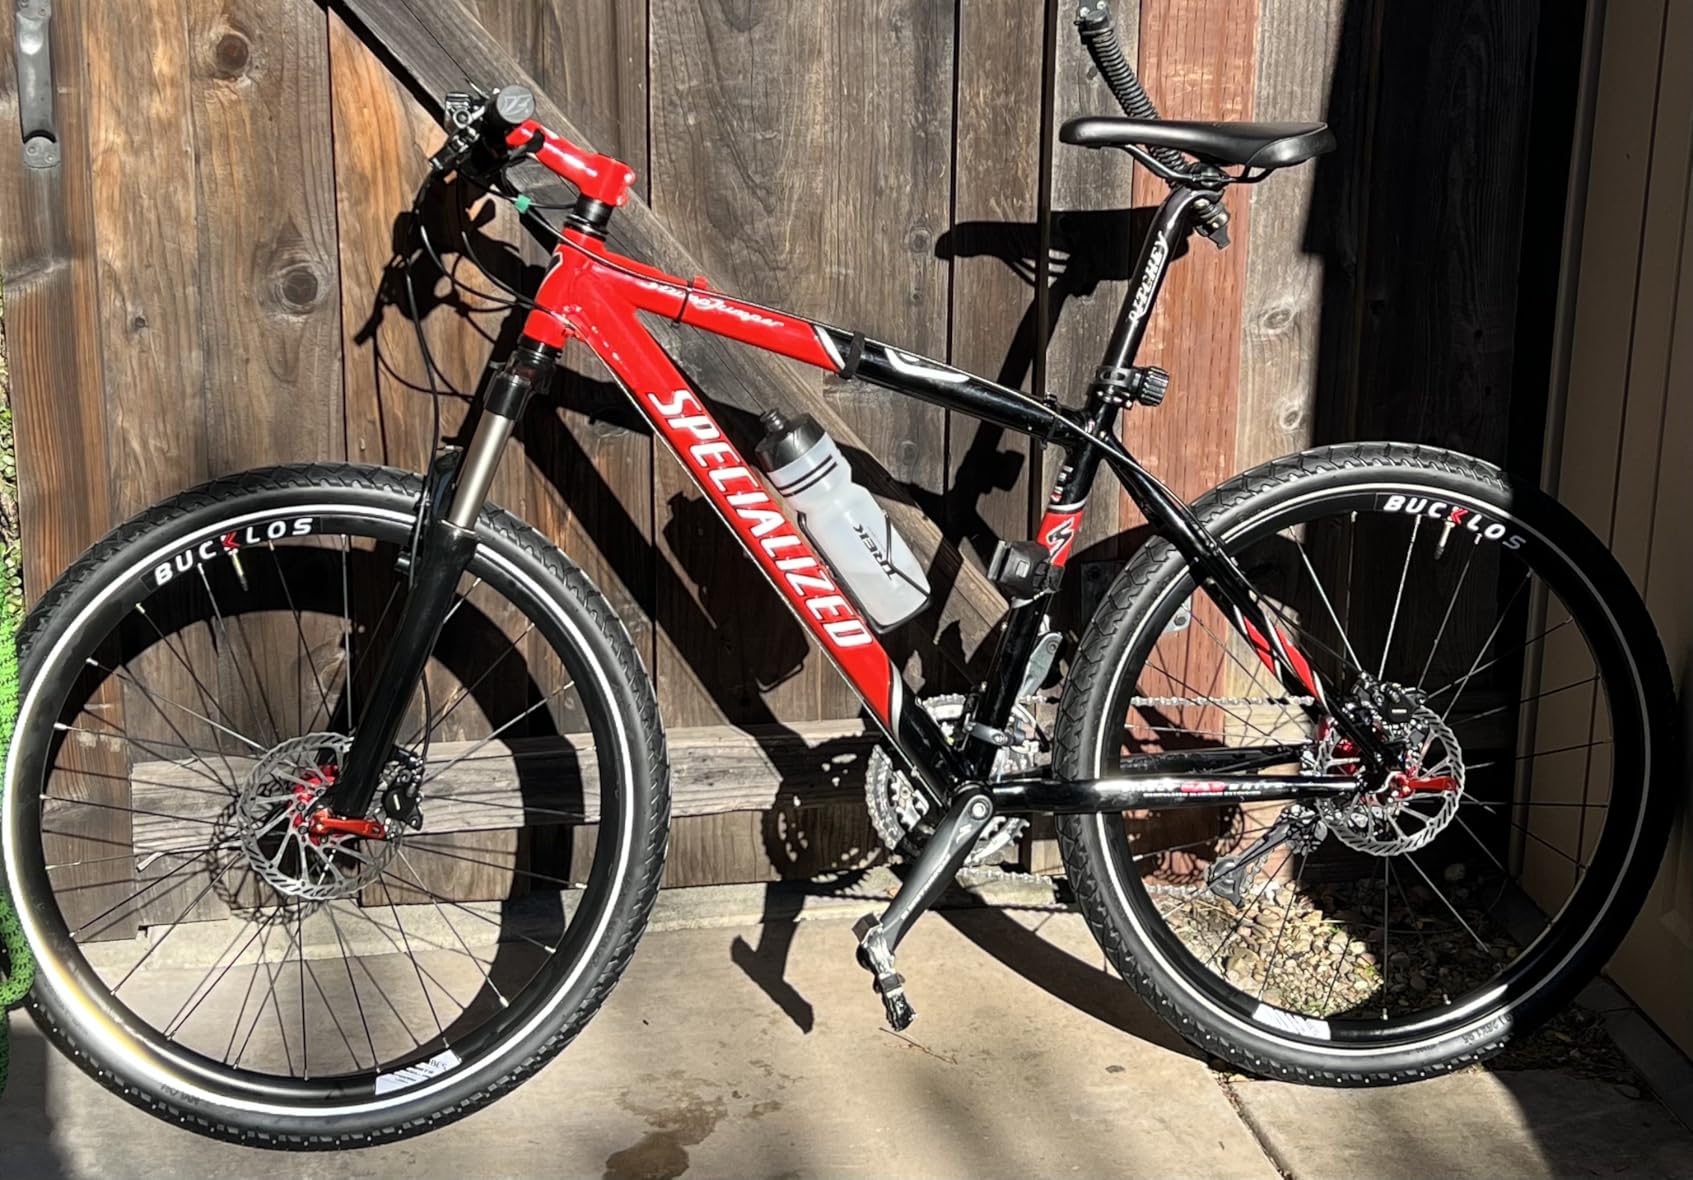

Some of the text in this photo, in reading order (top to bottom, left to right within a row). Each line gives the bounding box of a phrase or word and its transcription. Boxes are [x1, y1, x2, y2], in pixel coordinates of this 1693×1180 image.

[648, 389, 874, 648] SPECIALIZED
[1382, 494, 1527, 550] BUCKLOS
[153, 517, 314, 586] BUCKLOS
[852, 522, 897, 580] TREK
